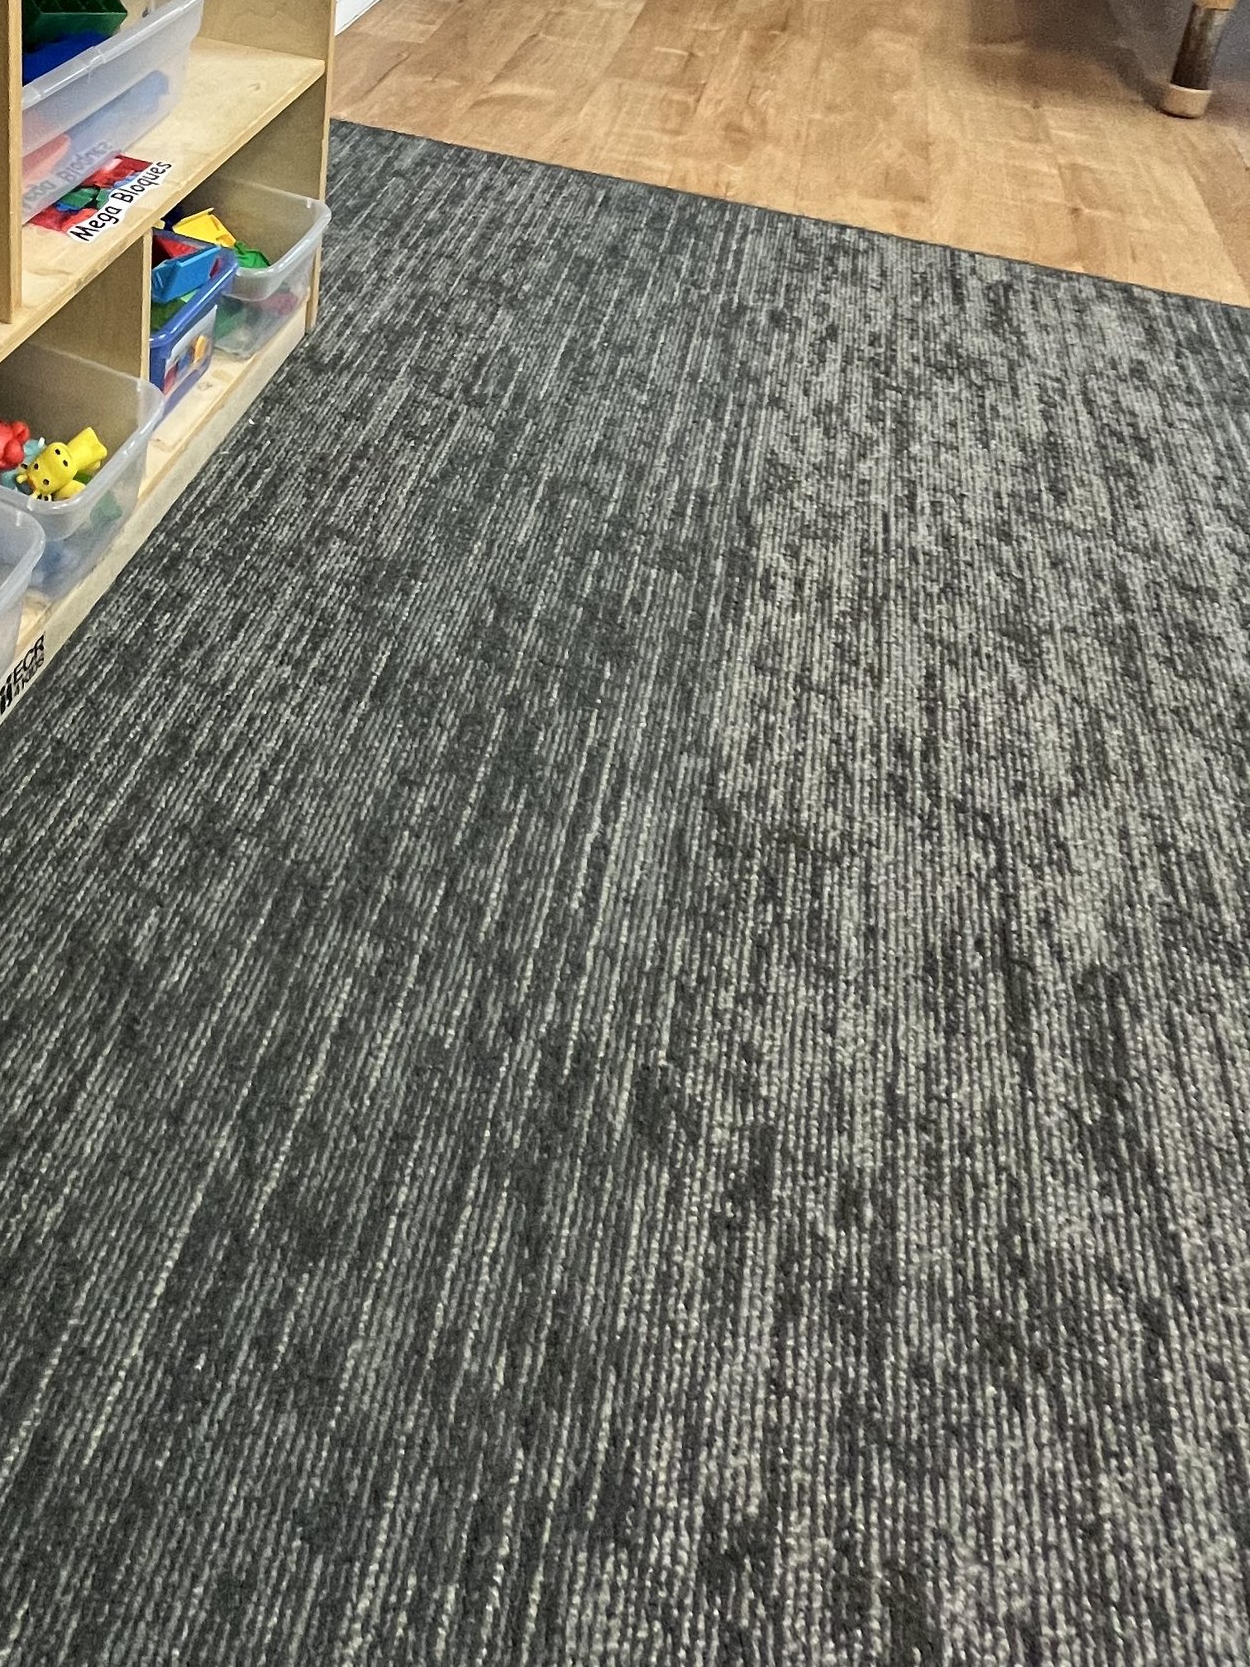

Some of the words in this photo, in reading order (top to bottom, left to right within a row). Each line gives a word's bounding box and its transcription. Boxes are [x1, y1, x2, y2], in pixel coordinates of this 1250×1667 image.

[69, 204, 122, 242] Mega
[110, 160, 173, 205] Bloques
[13, 633, 45, 685] ECR
